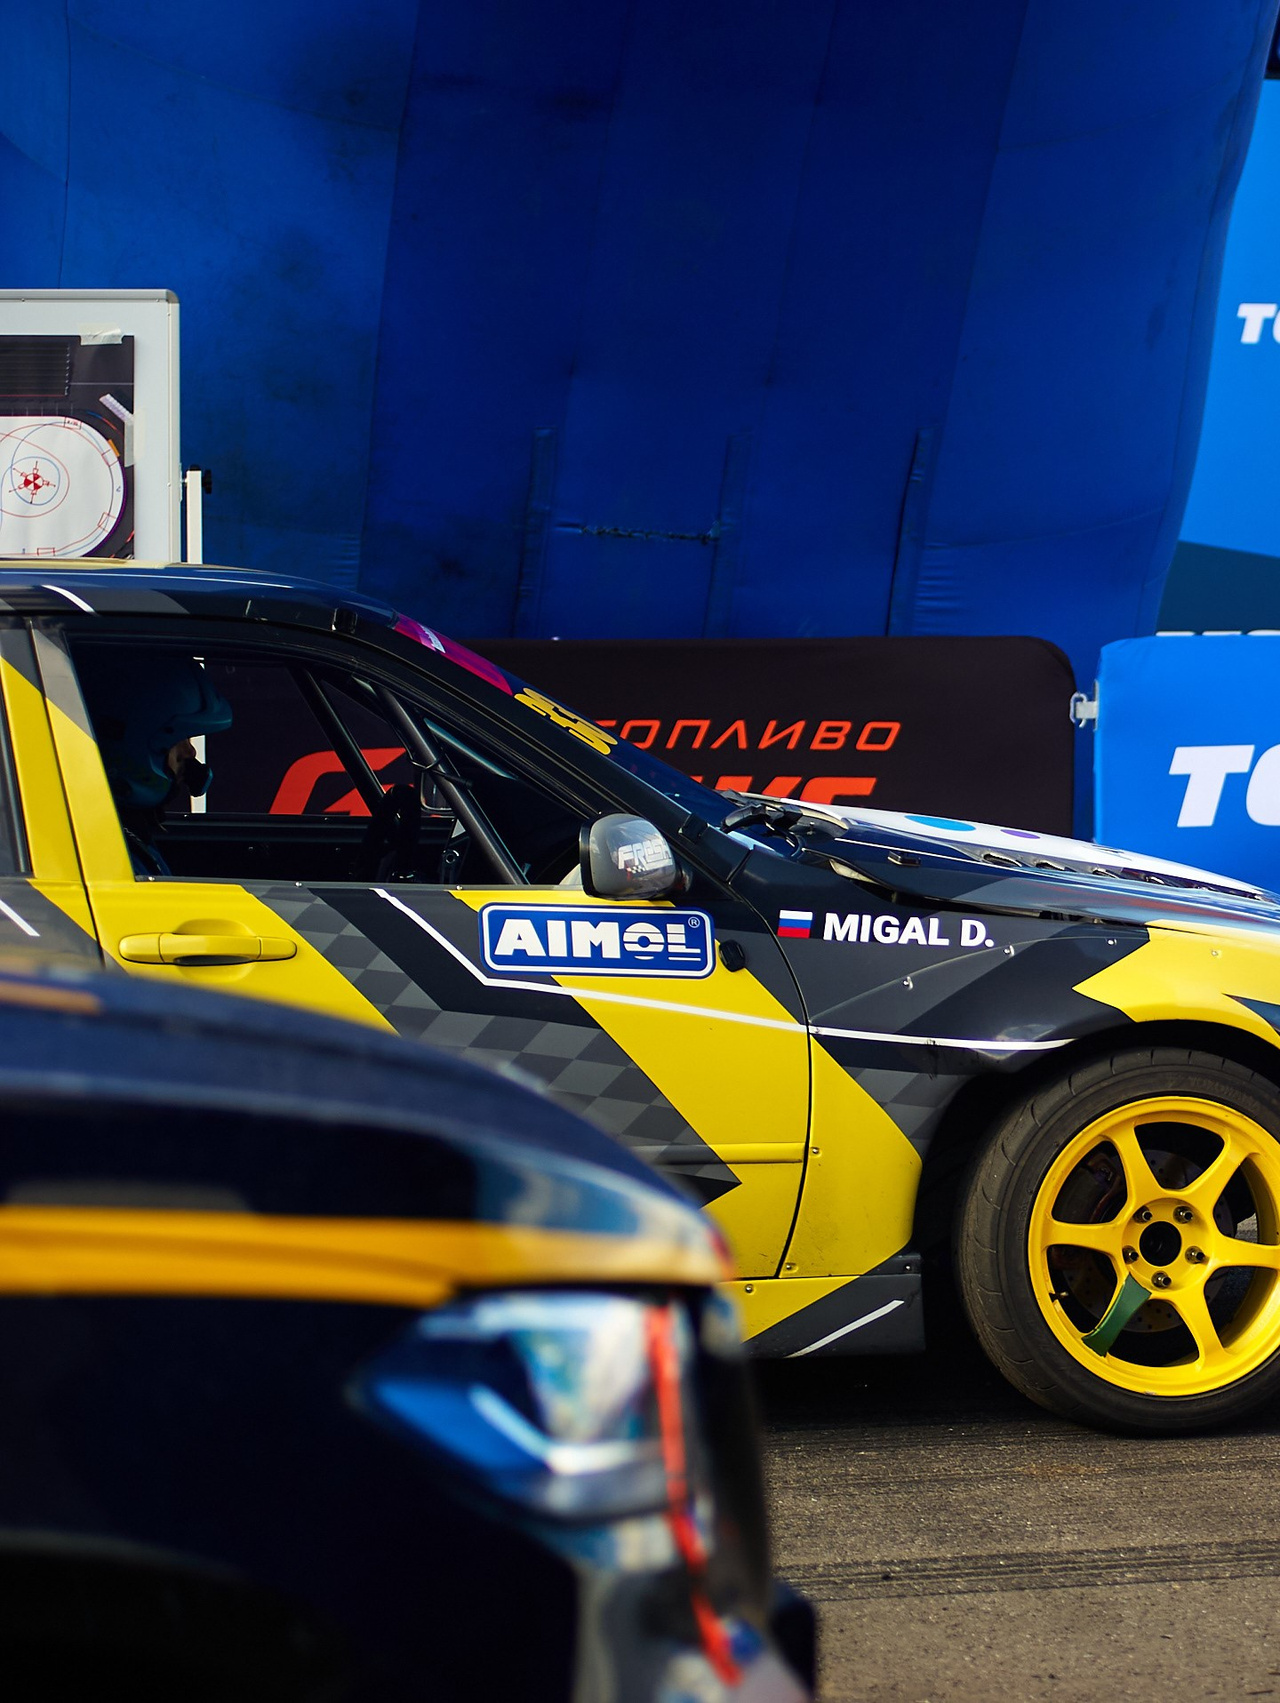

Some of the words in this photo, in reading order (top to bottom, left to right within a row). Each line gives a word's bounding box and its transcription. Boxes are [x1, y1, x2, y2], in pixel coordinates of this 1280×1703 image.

[494, 917, 702, 961] AIMOL
[823, 912, 950, 946] MIGAL
[960, 919, 995, 948] D.
